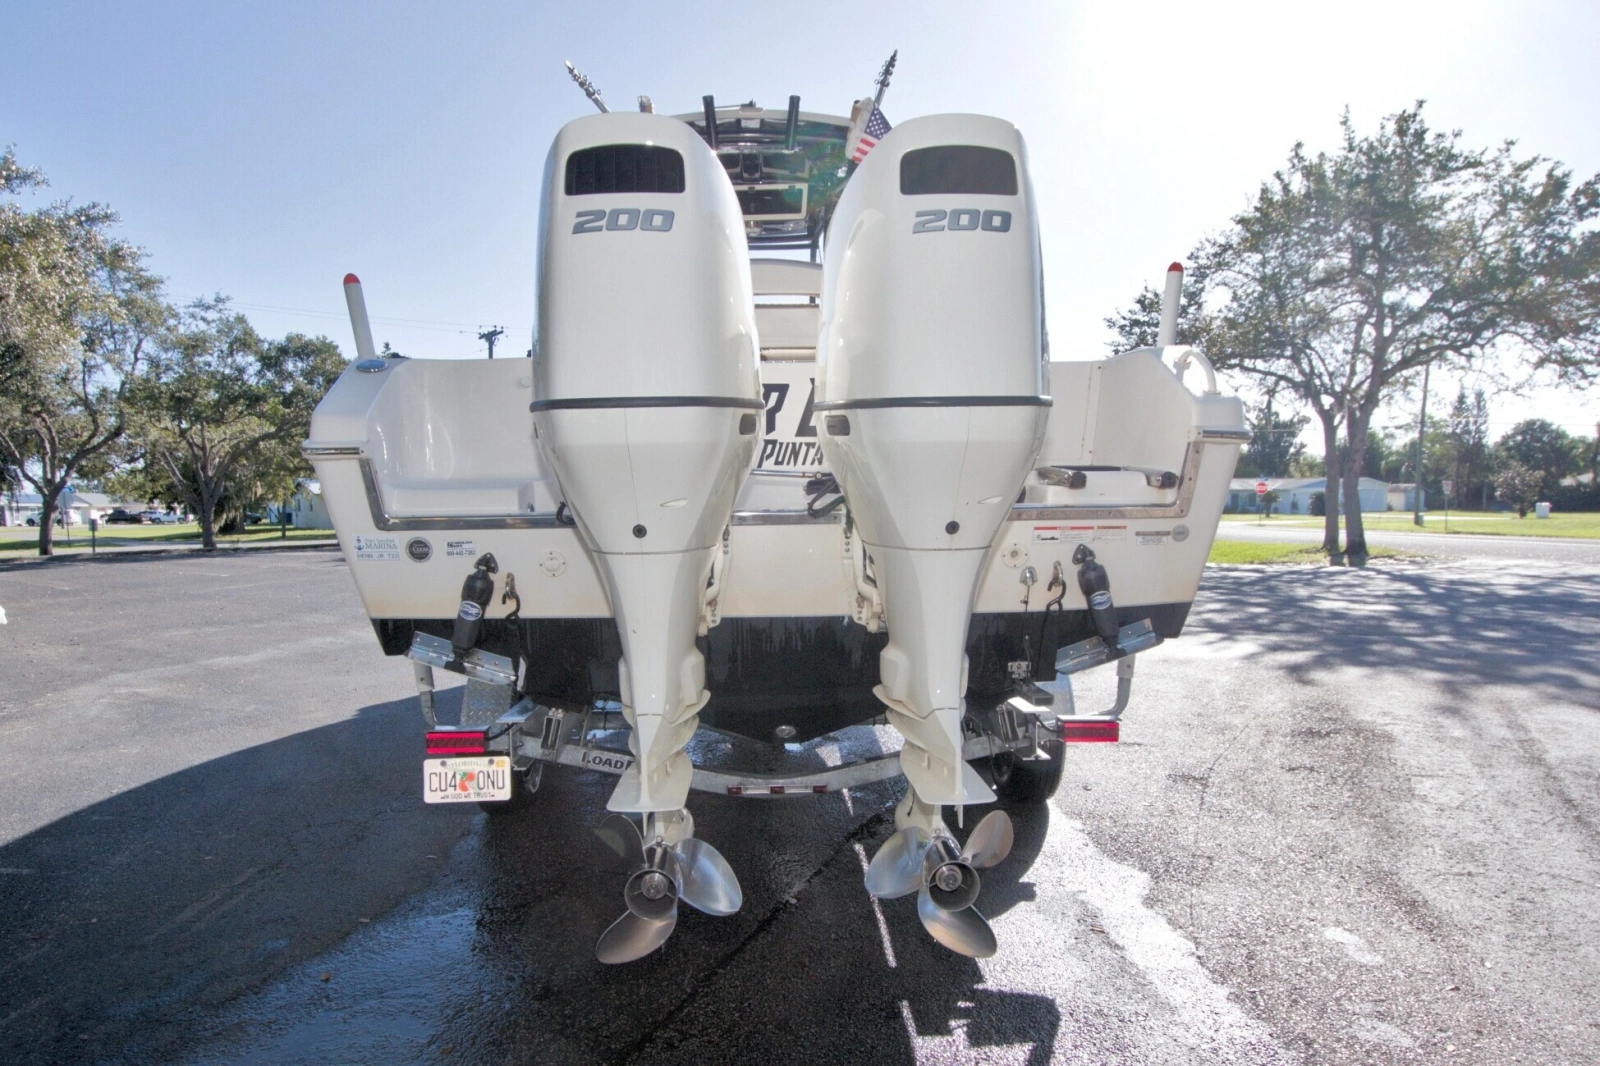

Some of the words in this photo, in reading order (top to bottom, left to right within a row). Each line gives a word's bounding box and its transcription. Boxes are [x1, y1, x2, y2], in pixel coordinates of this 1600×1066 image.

[572, 208, 675, 235] 200
[912, 208, 1012, 234] 200
[757, 439, 824, 469] PUNTA
[429, 771, 457, 792] CU4
